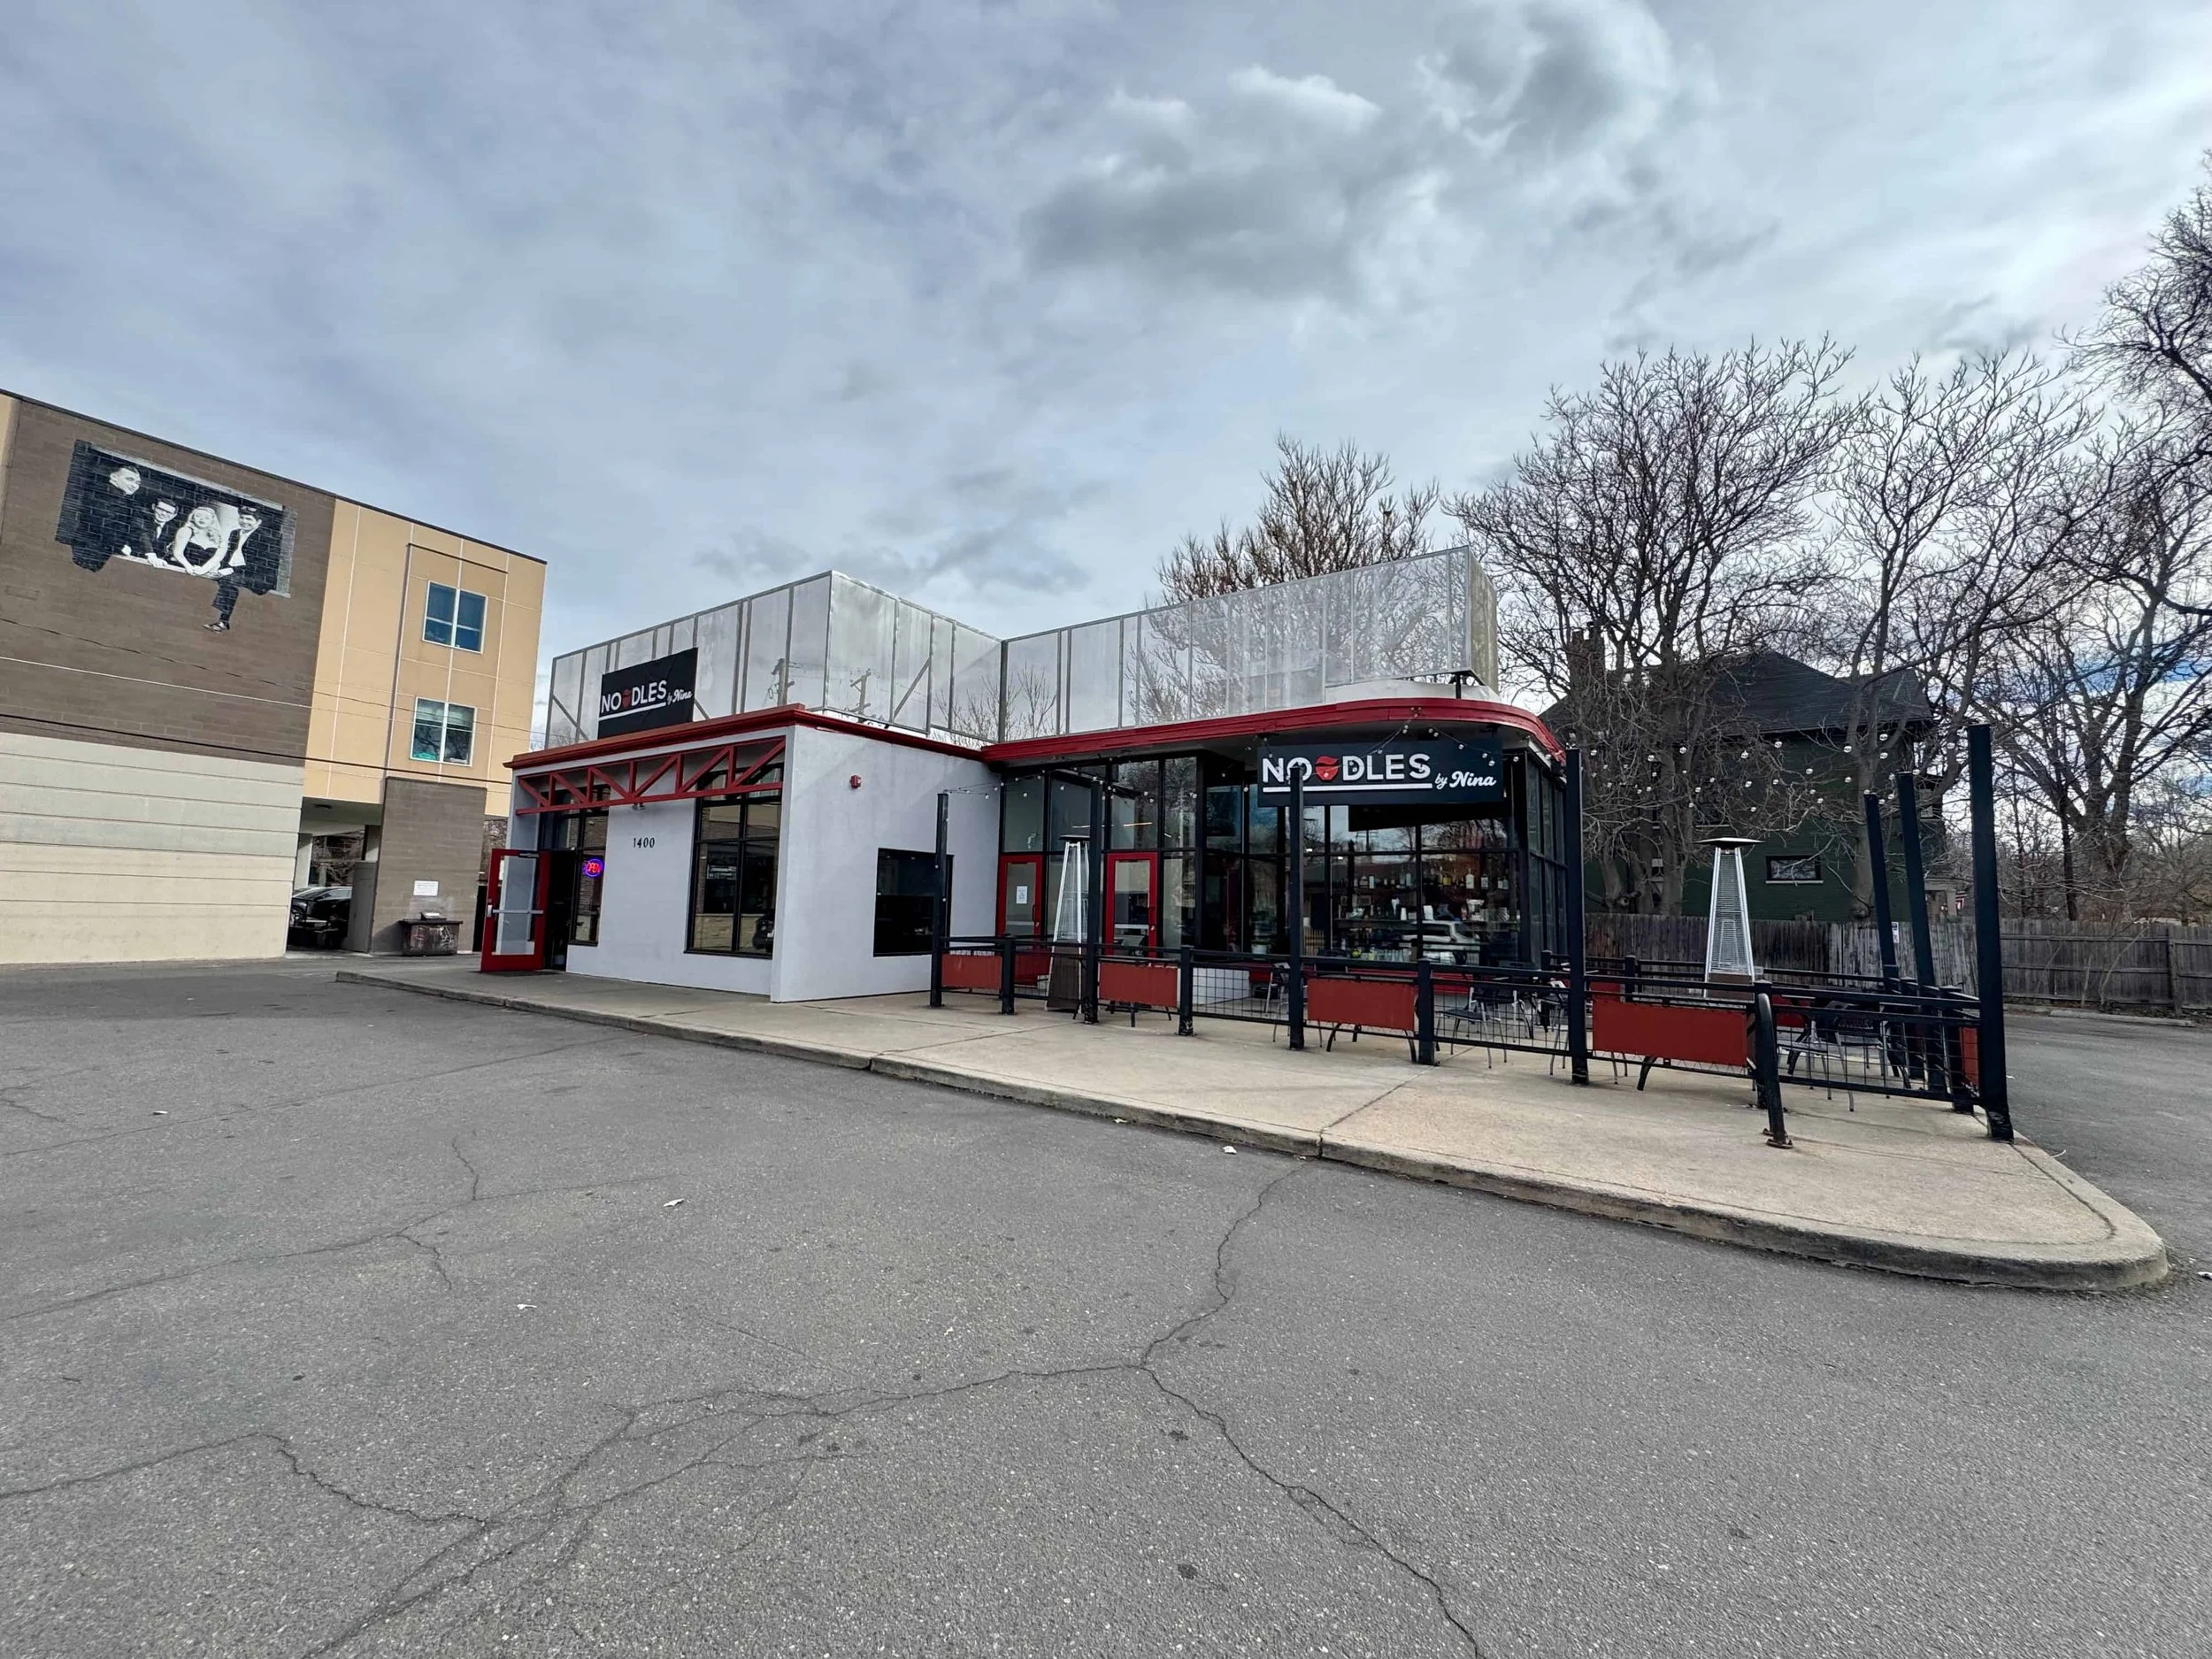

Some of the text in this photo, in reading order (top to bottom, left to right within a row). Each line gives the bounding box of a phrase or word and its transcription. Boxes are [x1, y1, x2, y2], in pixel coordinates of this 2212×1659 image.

[672, 688, 693, 703] Nina
[1434, 772, 1448, 789] by
[1449, 771, 1497, 788] Nina
[634, 837, 655, 849] 1400
